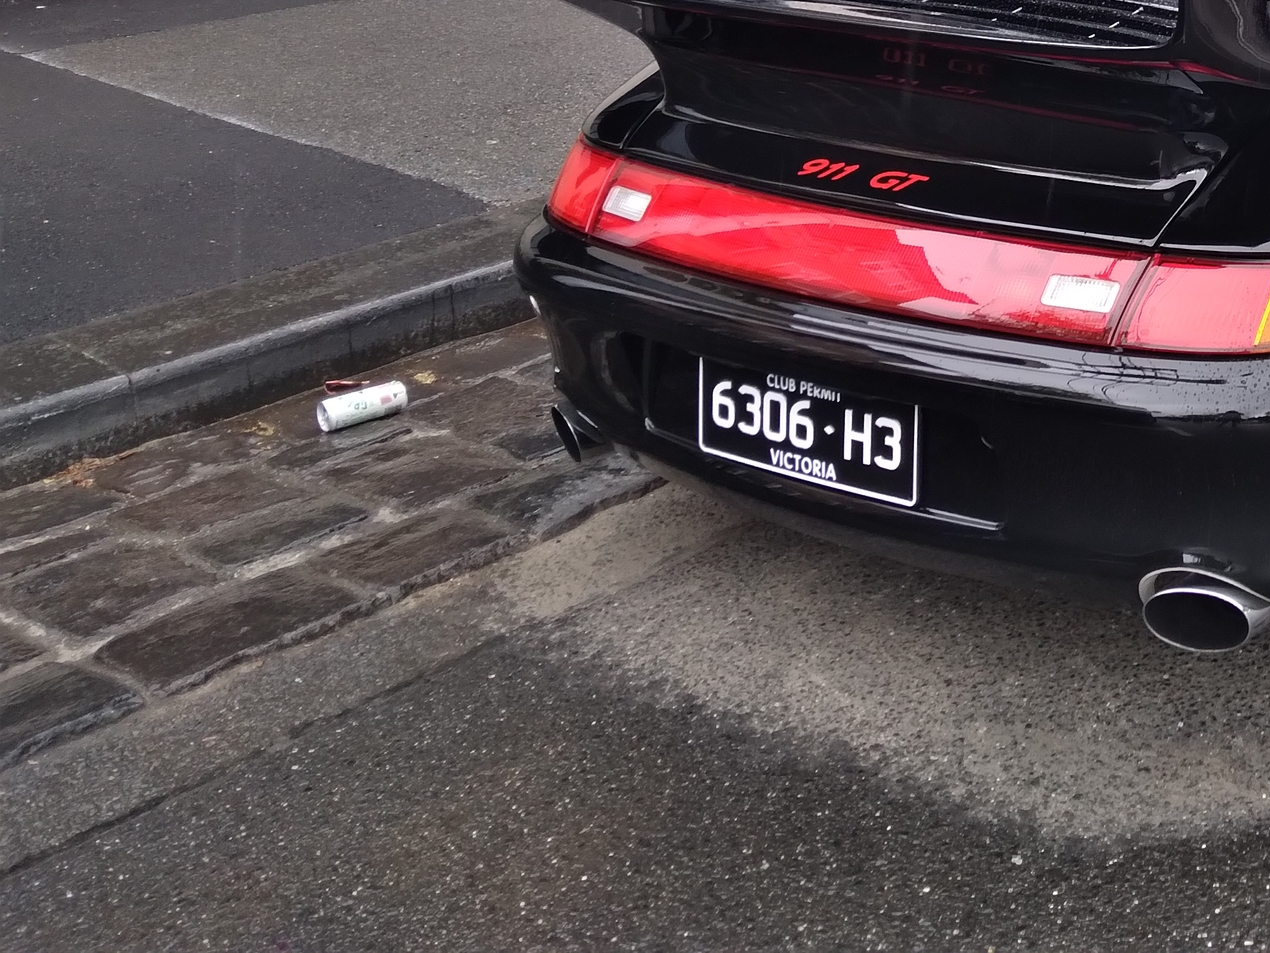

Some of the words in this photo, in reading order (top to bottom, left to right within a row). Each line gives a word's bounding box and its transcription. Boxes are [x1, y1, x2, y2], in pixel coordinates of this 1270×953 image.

[797, 158, 860, 181] 911
[869, 170, 930, 192] GT
[766, 374, 797, 392] CLUB
[712, 380, 814, 450] 6306
[843, 408, 902, 472] H3
[769, 448, 837, 481] VICTORIA
